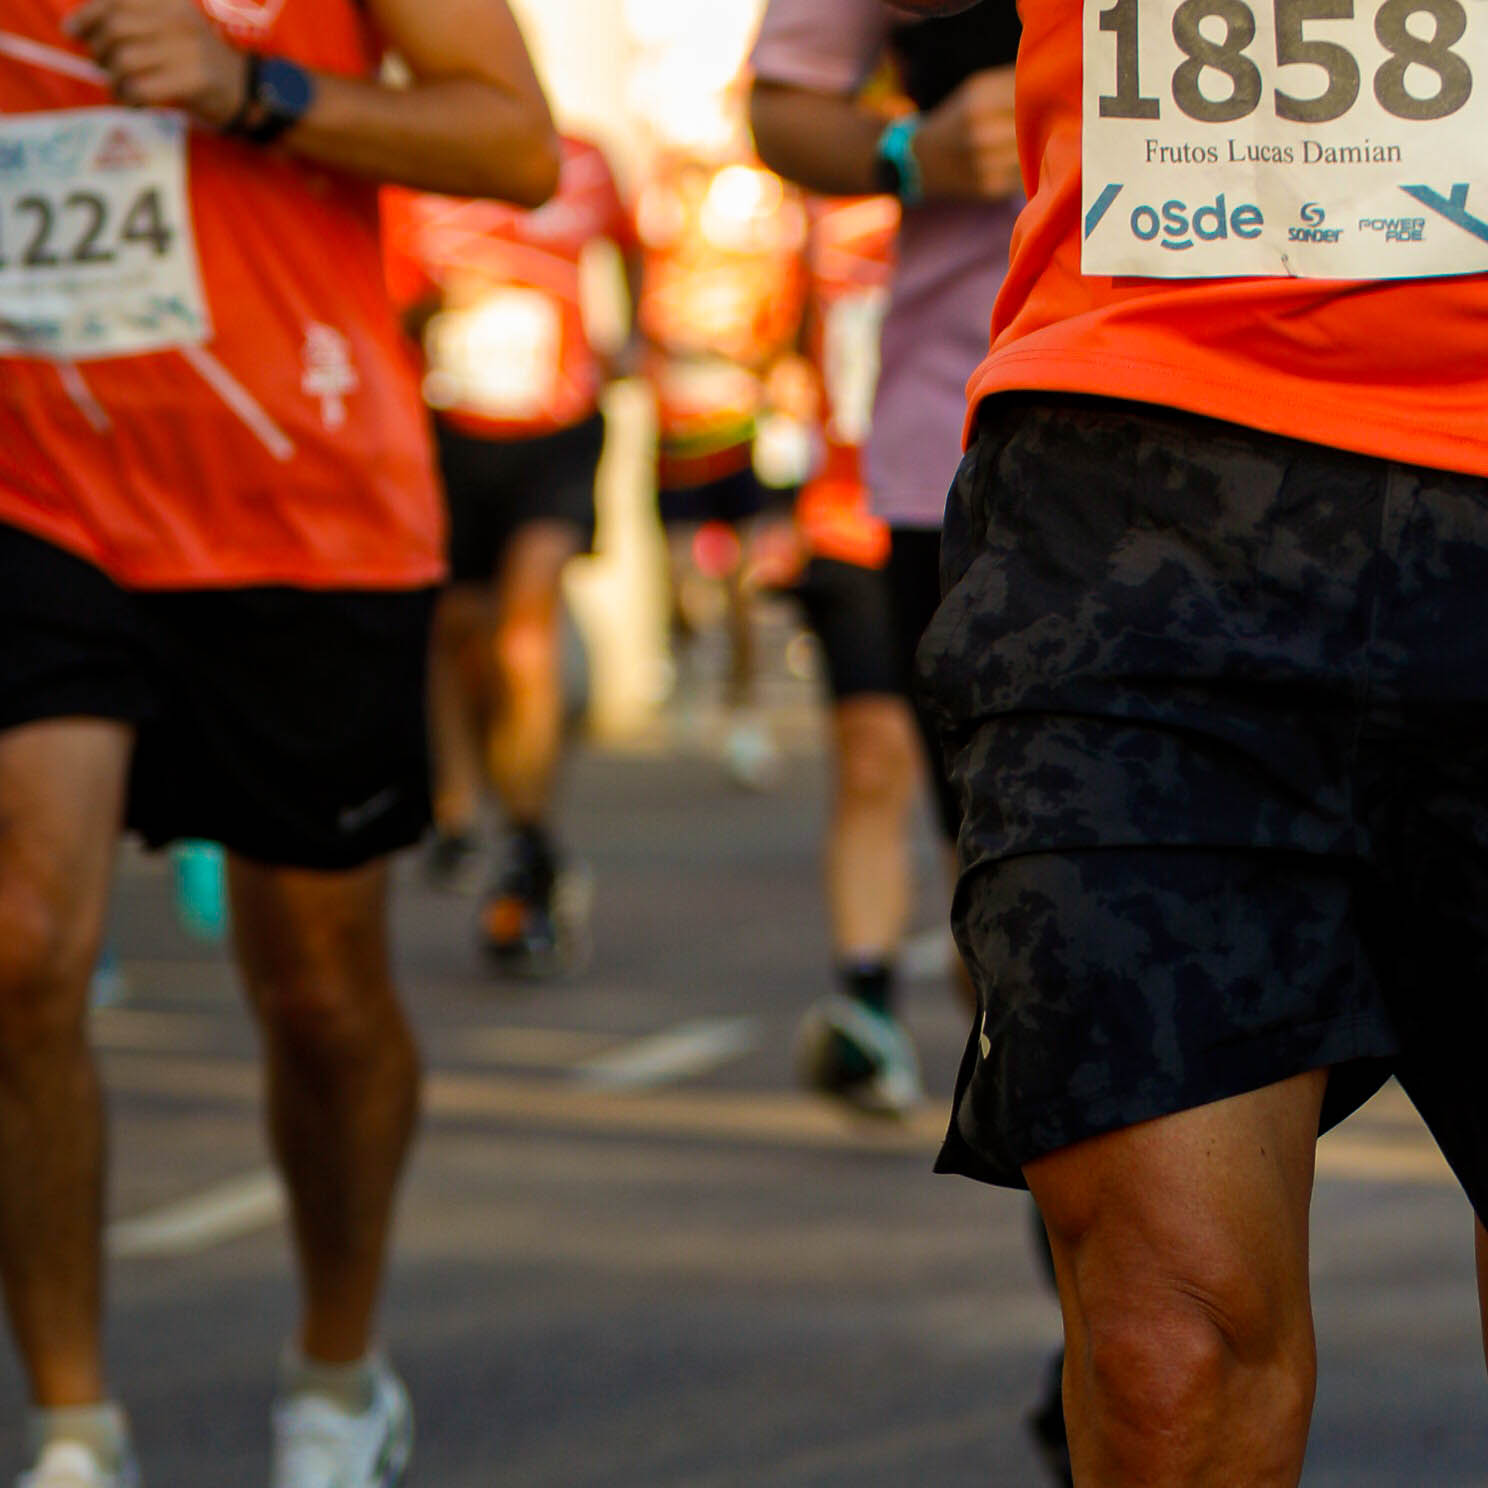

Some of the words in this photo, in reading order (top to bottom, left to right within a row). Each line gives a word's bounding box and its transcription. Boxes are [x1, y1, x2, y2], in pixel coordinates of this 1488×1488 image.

[1145, 138, 1219, 164] Frutos
[1227, 138, 1294, 164] Lucas
[1302, 138, 1402, 164] Damian
[1130, 192, 1265, 243] osde
